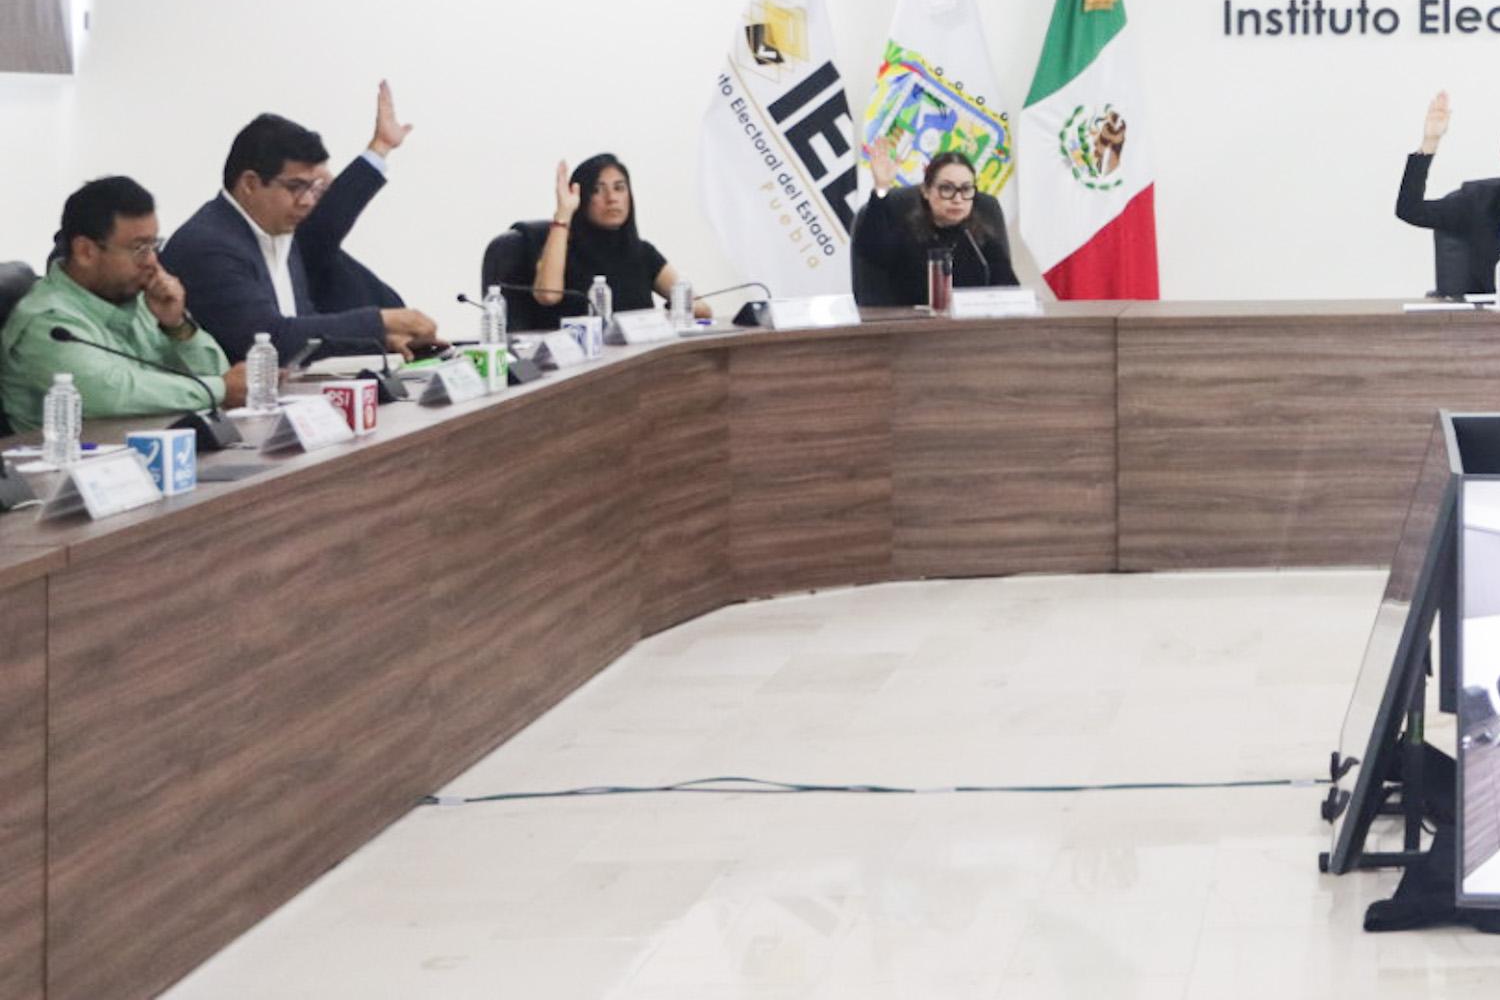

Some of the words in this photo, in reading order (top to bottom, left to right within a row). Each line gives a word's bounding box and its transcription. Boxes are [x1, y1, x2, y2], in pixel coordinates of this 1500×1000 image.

[730, 96, 785, 173] Electoral
[776, 164, 802, 202] del
[796, 199, 837, 257] Estado
